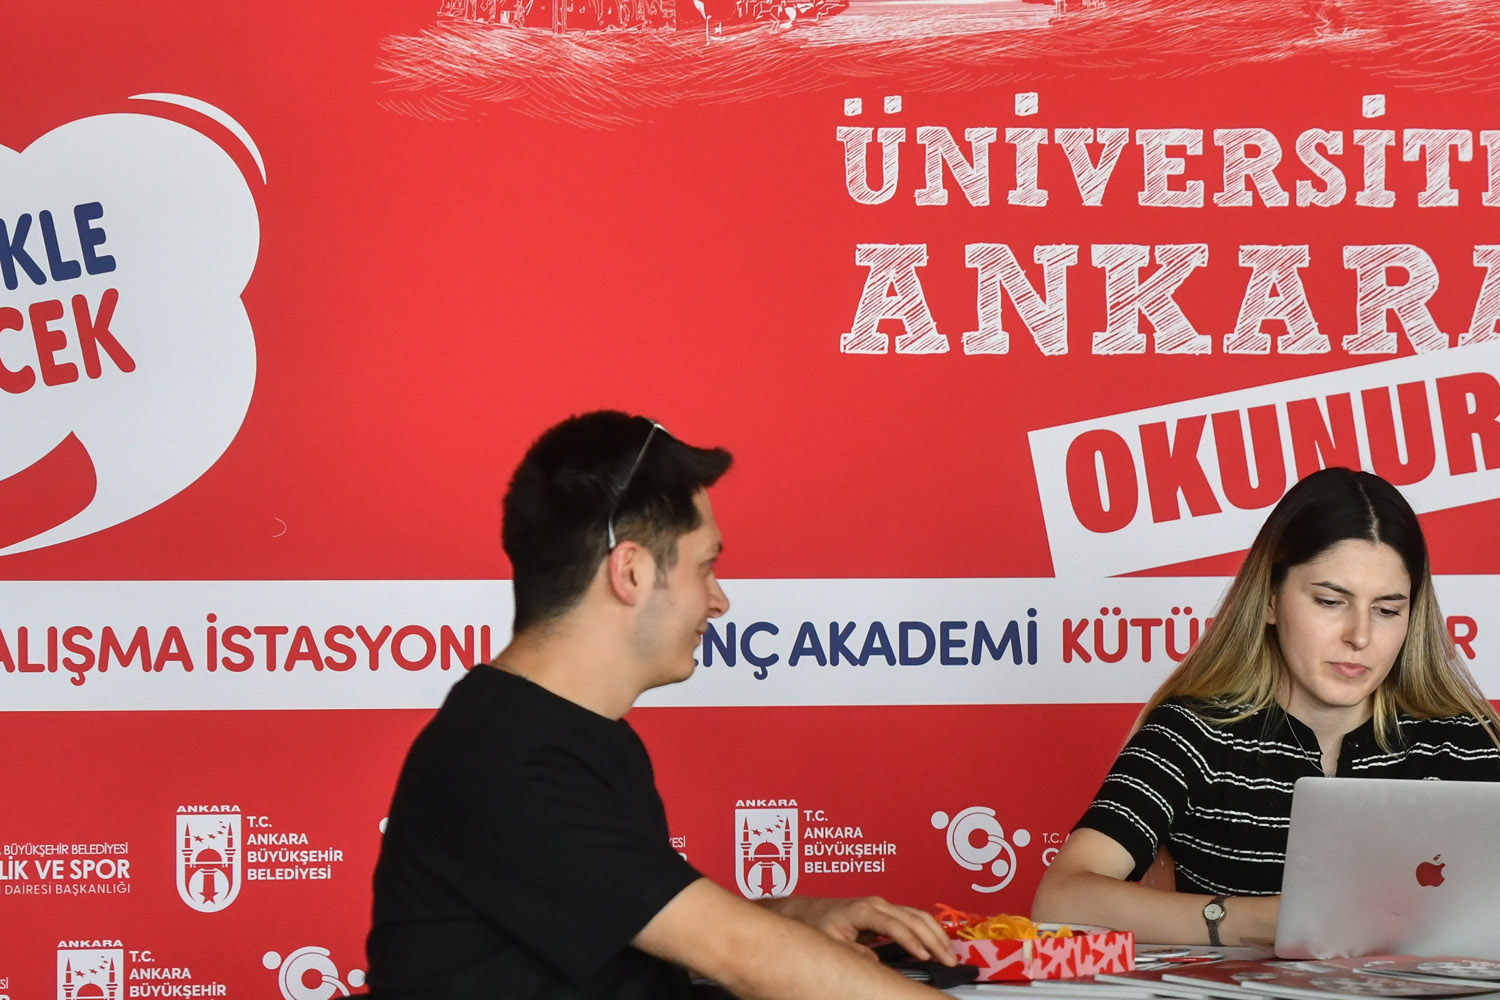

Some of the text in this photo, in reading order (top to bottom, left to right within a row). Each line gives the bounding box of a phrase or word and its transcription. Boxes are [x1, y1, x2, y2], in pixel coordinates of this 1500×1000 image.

[788, 607, 1038, 667] AKADEMİ
[176, 804, 241, 813] ANKARA
[735, 799, 798, 807] ANKARA
[247, 816, 272, 828] T.C.
[804, 810, 828, 821] T.C.
[247, 833, 309, 846] ANKARA
[804, 827, 863, 839] ANKARA
[4, 841, 129, 857] BÜYÜKŞEHİR BELEDİYESİ
[247, 847, 343, 865] BÜYÜKŞEHİR
[804, 841, 897, 858] BÜYÜKŞEHİR
[35, 859, 64, 880] VE
[69, 858, 130, 880] SPOR
[804, 857, 885, 874] BELEDİYESİ
[247, 865, 331, 881] BELEDİYESİ
[5, 881, 131, 896] DAİRESİ BAŞKANLIĞI
[57, 939, 123, 948] ANKARA
[129, 951, 155, 962] T.C.
[129, 967, 191, 980] ANKARA
[129, 981, 226, 999] BÜYÜKŞEHİR
